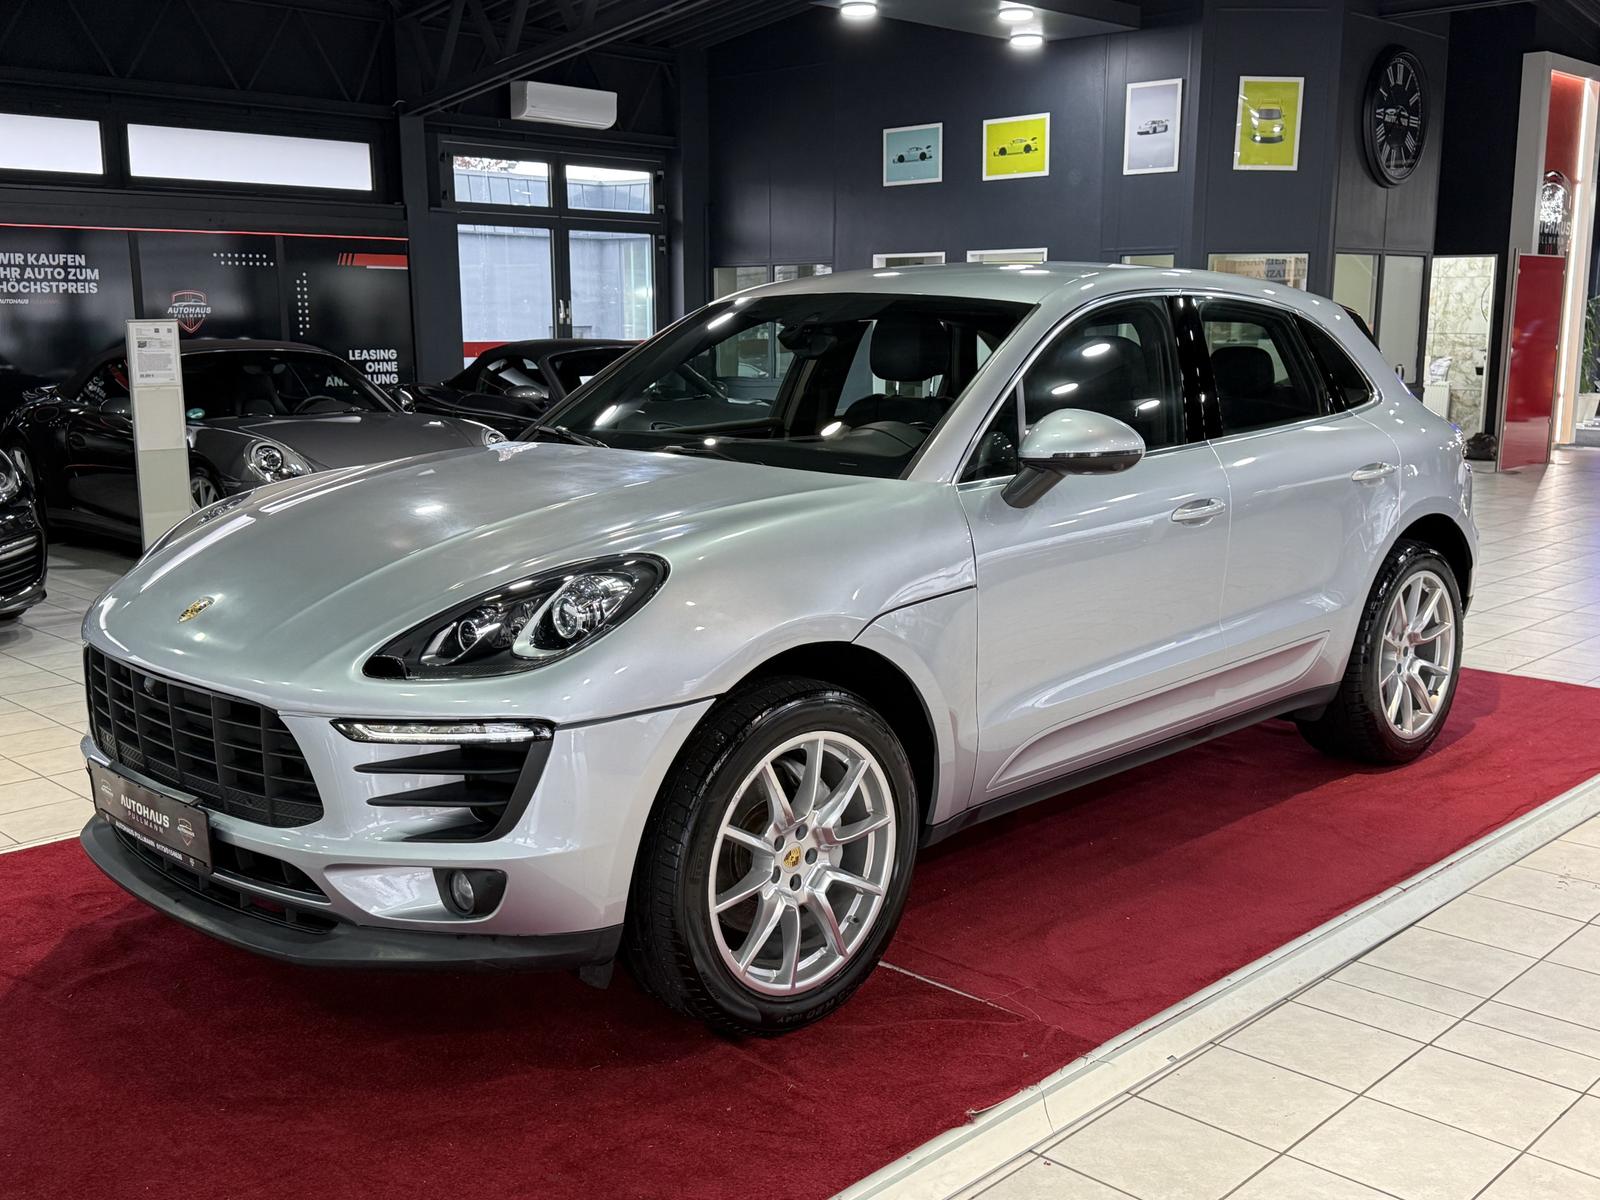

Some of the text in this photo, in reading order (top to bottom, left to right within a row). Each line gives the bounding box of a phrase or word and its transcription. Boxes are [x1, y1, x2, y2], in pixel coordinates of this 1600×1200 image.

[27, 253, 86, 266] KAUFEN
[0, 266, 100, 280] HR AUTO ZUM
[0, 278, 98, 293] HÖCHSTPREIS
[167, 306, 212, 315] AUTOHAUS
[348, 349, 398, 361] LEASING
[365, 361, 399, 373] OHNE
[120, 793, 170, 828] AUTOHAUS
